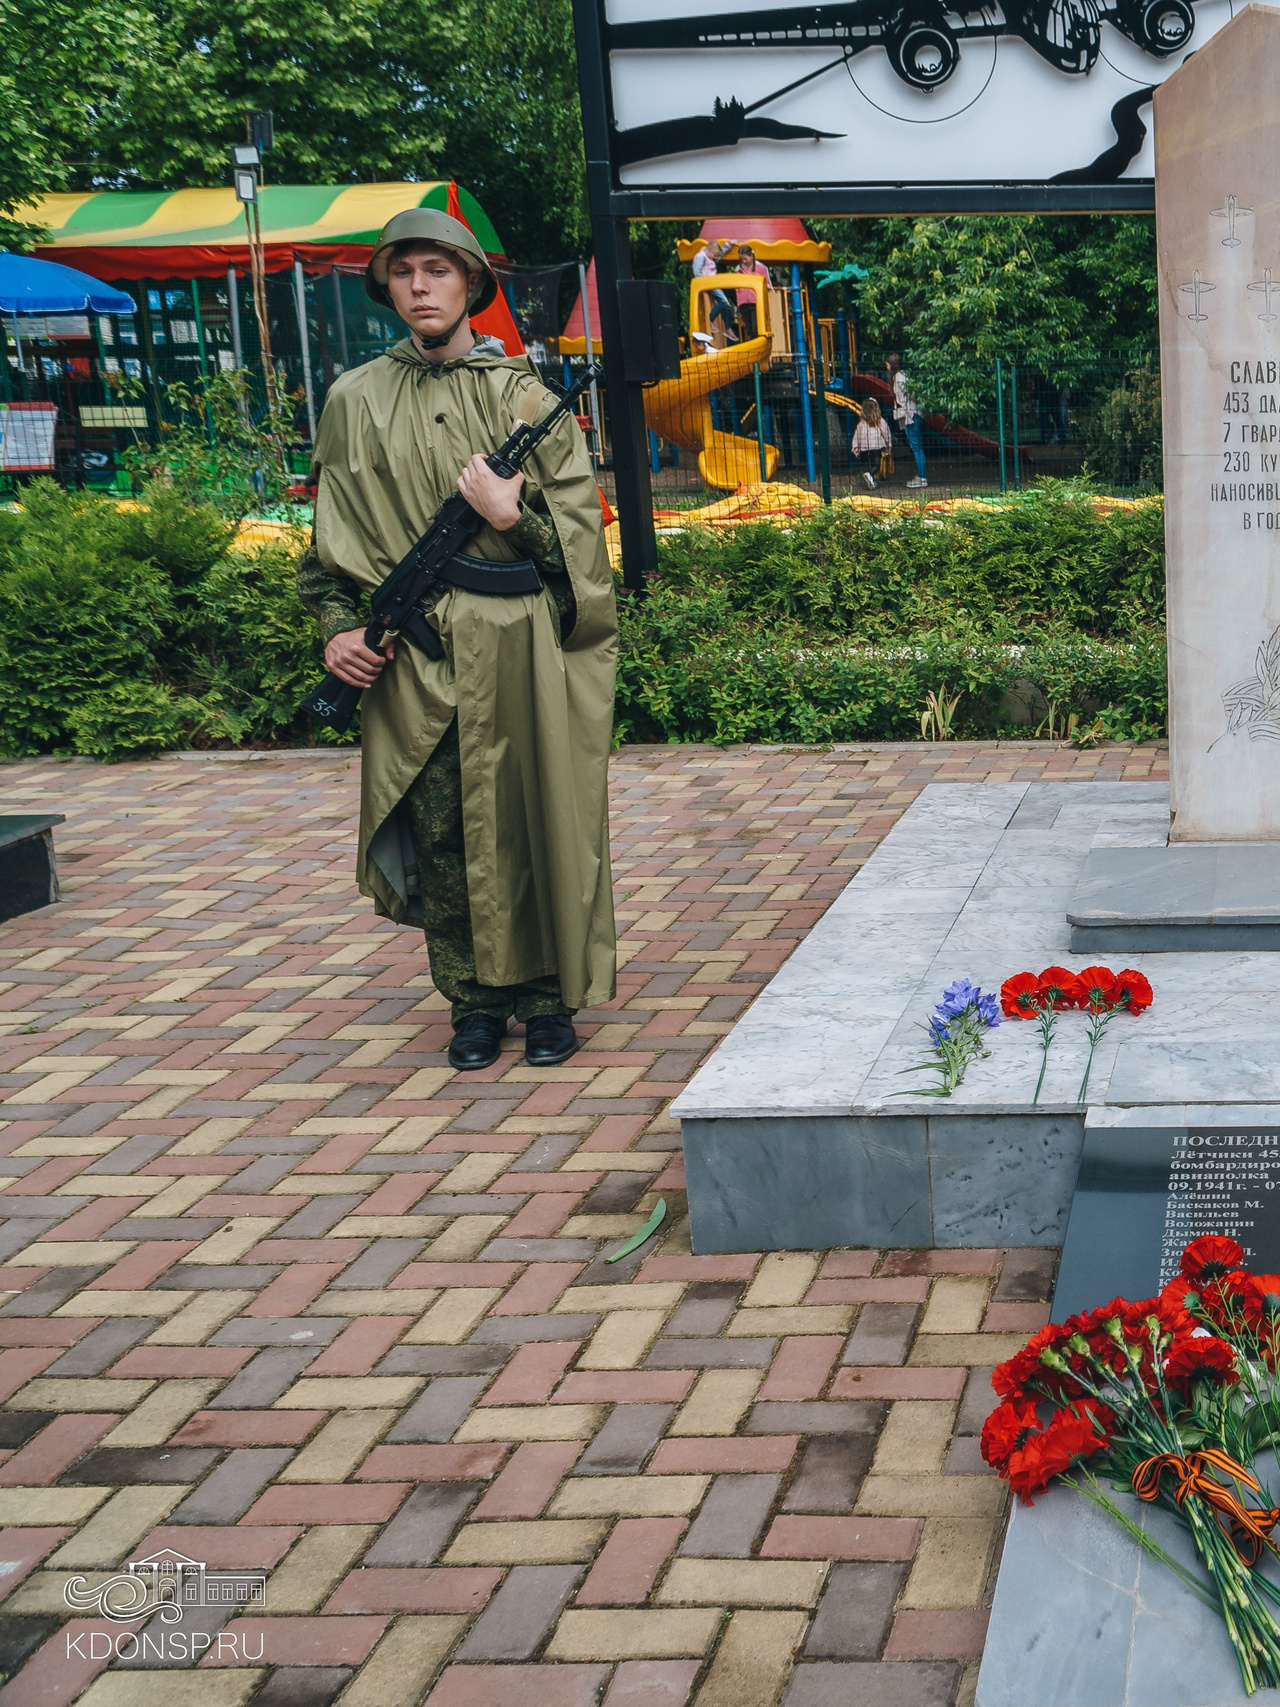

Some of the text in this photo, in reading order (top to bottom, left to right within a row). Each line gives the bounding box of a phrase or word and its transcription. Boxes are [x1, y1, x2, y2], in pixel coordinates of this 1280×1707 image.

[1223, 392, 1249, 413] 453
[1223, 423, 1231, 443] 7
[1224, 452, 1250, 472] 230
[1243, 512, 1251, 530] В
[1171, 1150, 1253, 1159] Лётчики
